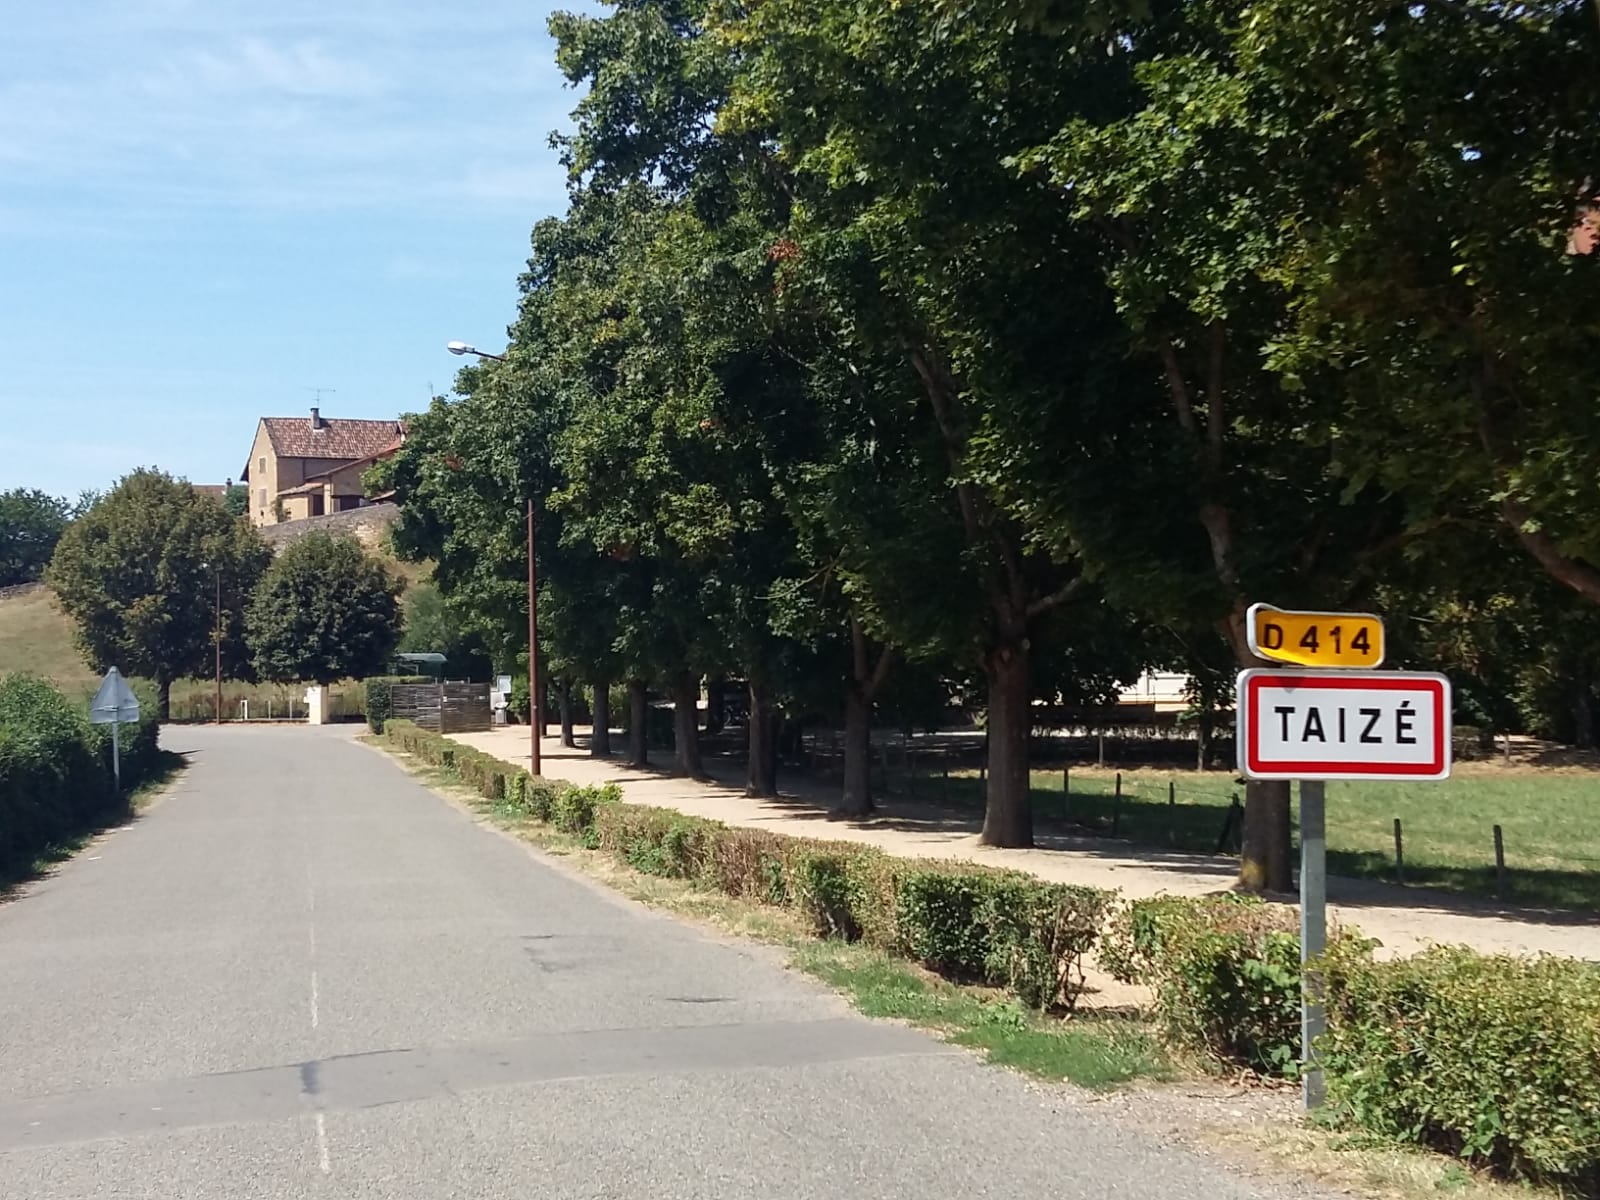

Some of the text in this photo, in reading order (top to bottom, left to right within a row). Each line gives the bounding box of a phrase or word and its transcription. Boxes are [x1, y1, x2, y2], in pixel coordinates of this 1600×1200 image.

[1263, 624, 1371, 655] D 414
[1274, 701, 1417, 744] TAIZÉ
